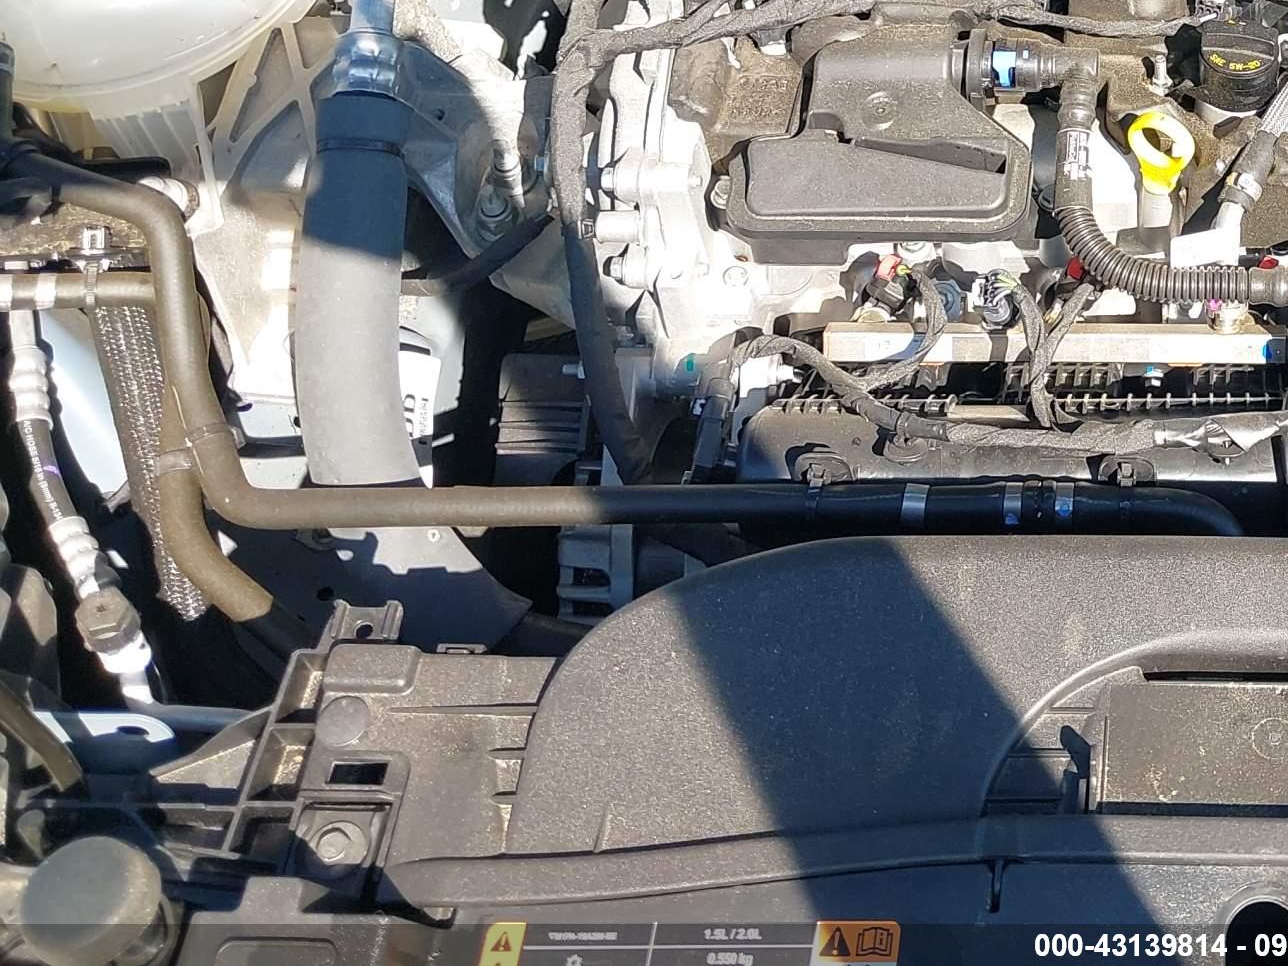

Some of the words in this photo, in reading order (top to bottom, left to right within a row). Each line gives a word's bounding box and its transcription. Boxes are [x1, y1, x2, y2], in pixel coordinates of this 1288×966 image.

[1209, 54, 1226, 67] SAE
[1228, 60, 1261, 71] 5W-20
[26, 434, 38, 458] HOSE
[703, 927, 729, 940] 1.5L
[735, 927, 762, 940] 2.0L
[706, 952, 738, 965] 0.550
[737, 952, 754, 966] kg
